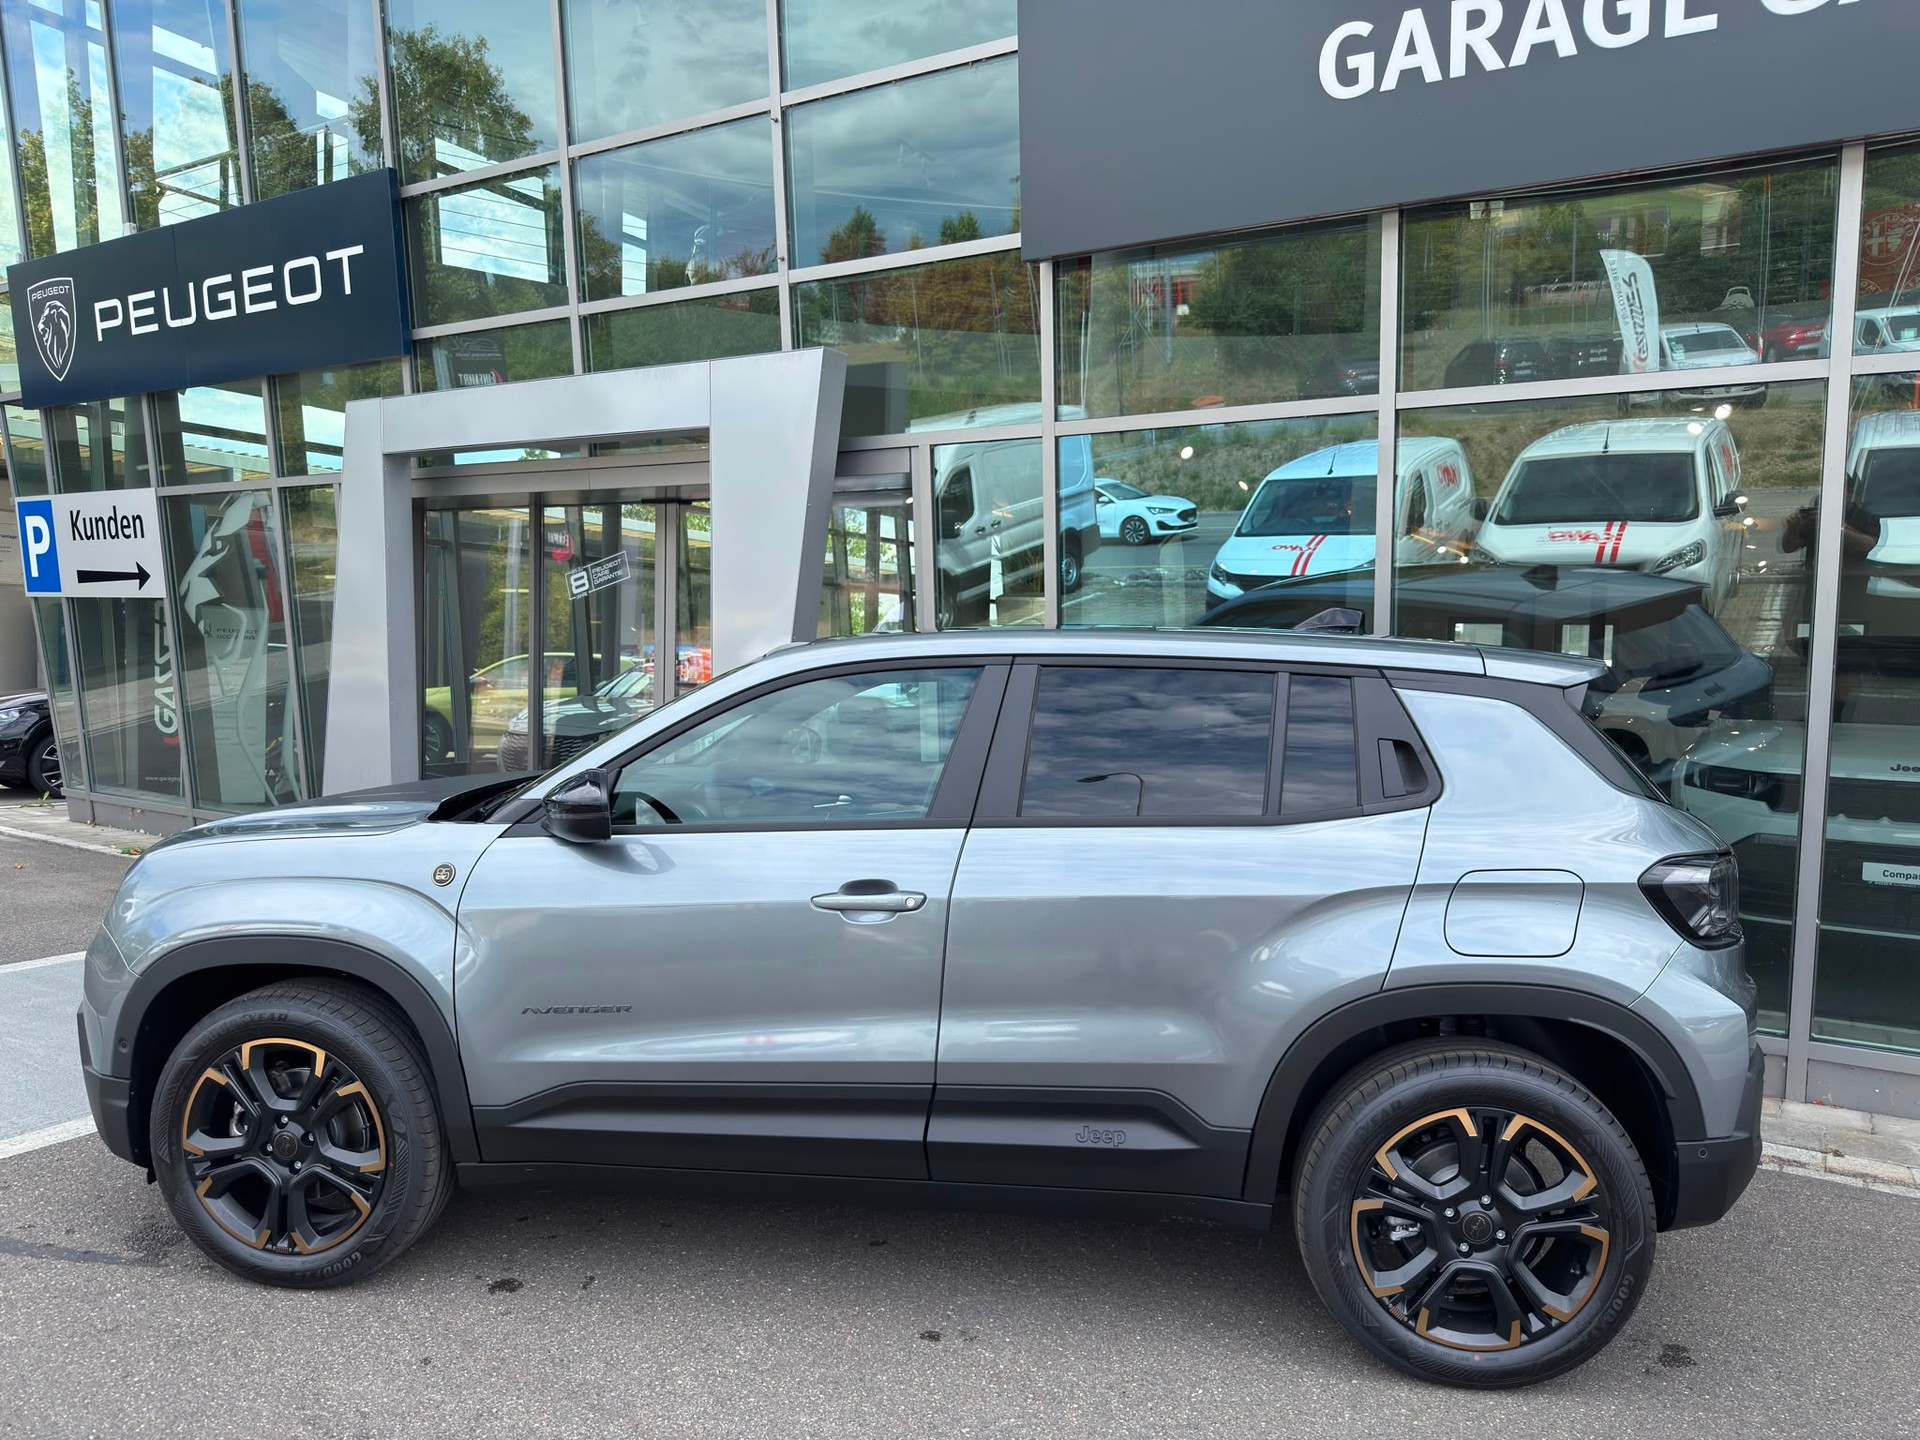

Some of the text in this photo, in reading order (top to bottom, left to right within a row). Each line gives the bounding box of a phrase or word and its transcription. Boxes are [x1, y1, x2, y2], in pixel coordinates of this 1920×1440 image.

[31, 285, 70, 302] PEUGEOT
[94, 244, 364, 342] PEUGEOT
[69, 505, 145, 541] Kunden
[24, 515, 50, 578] P
[592, 558, 622, 574] PEUGEOT
[593, 569, 611, 580] CARE
[570, 570, 590, 594] 8
[521, 1004, 633, 1015] AVENGER
[1075, 1125, 1126, 1147] Jeep
